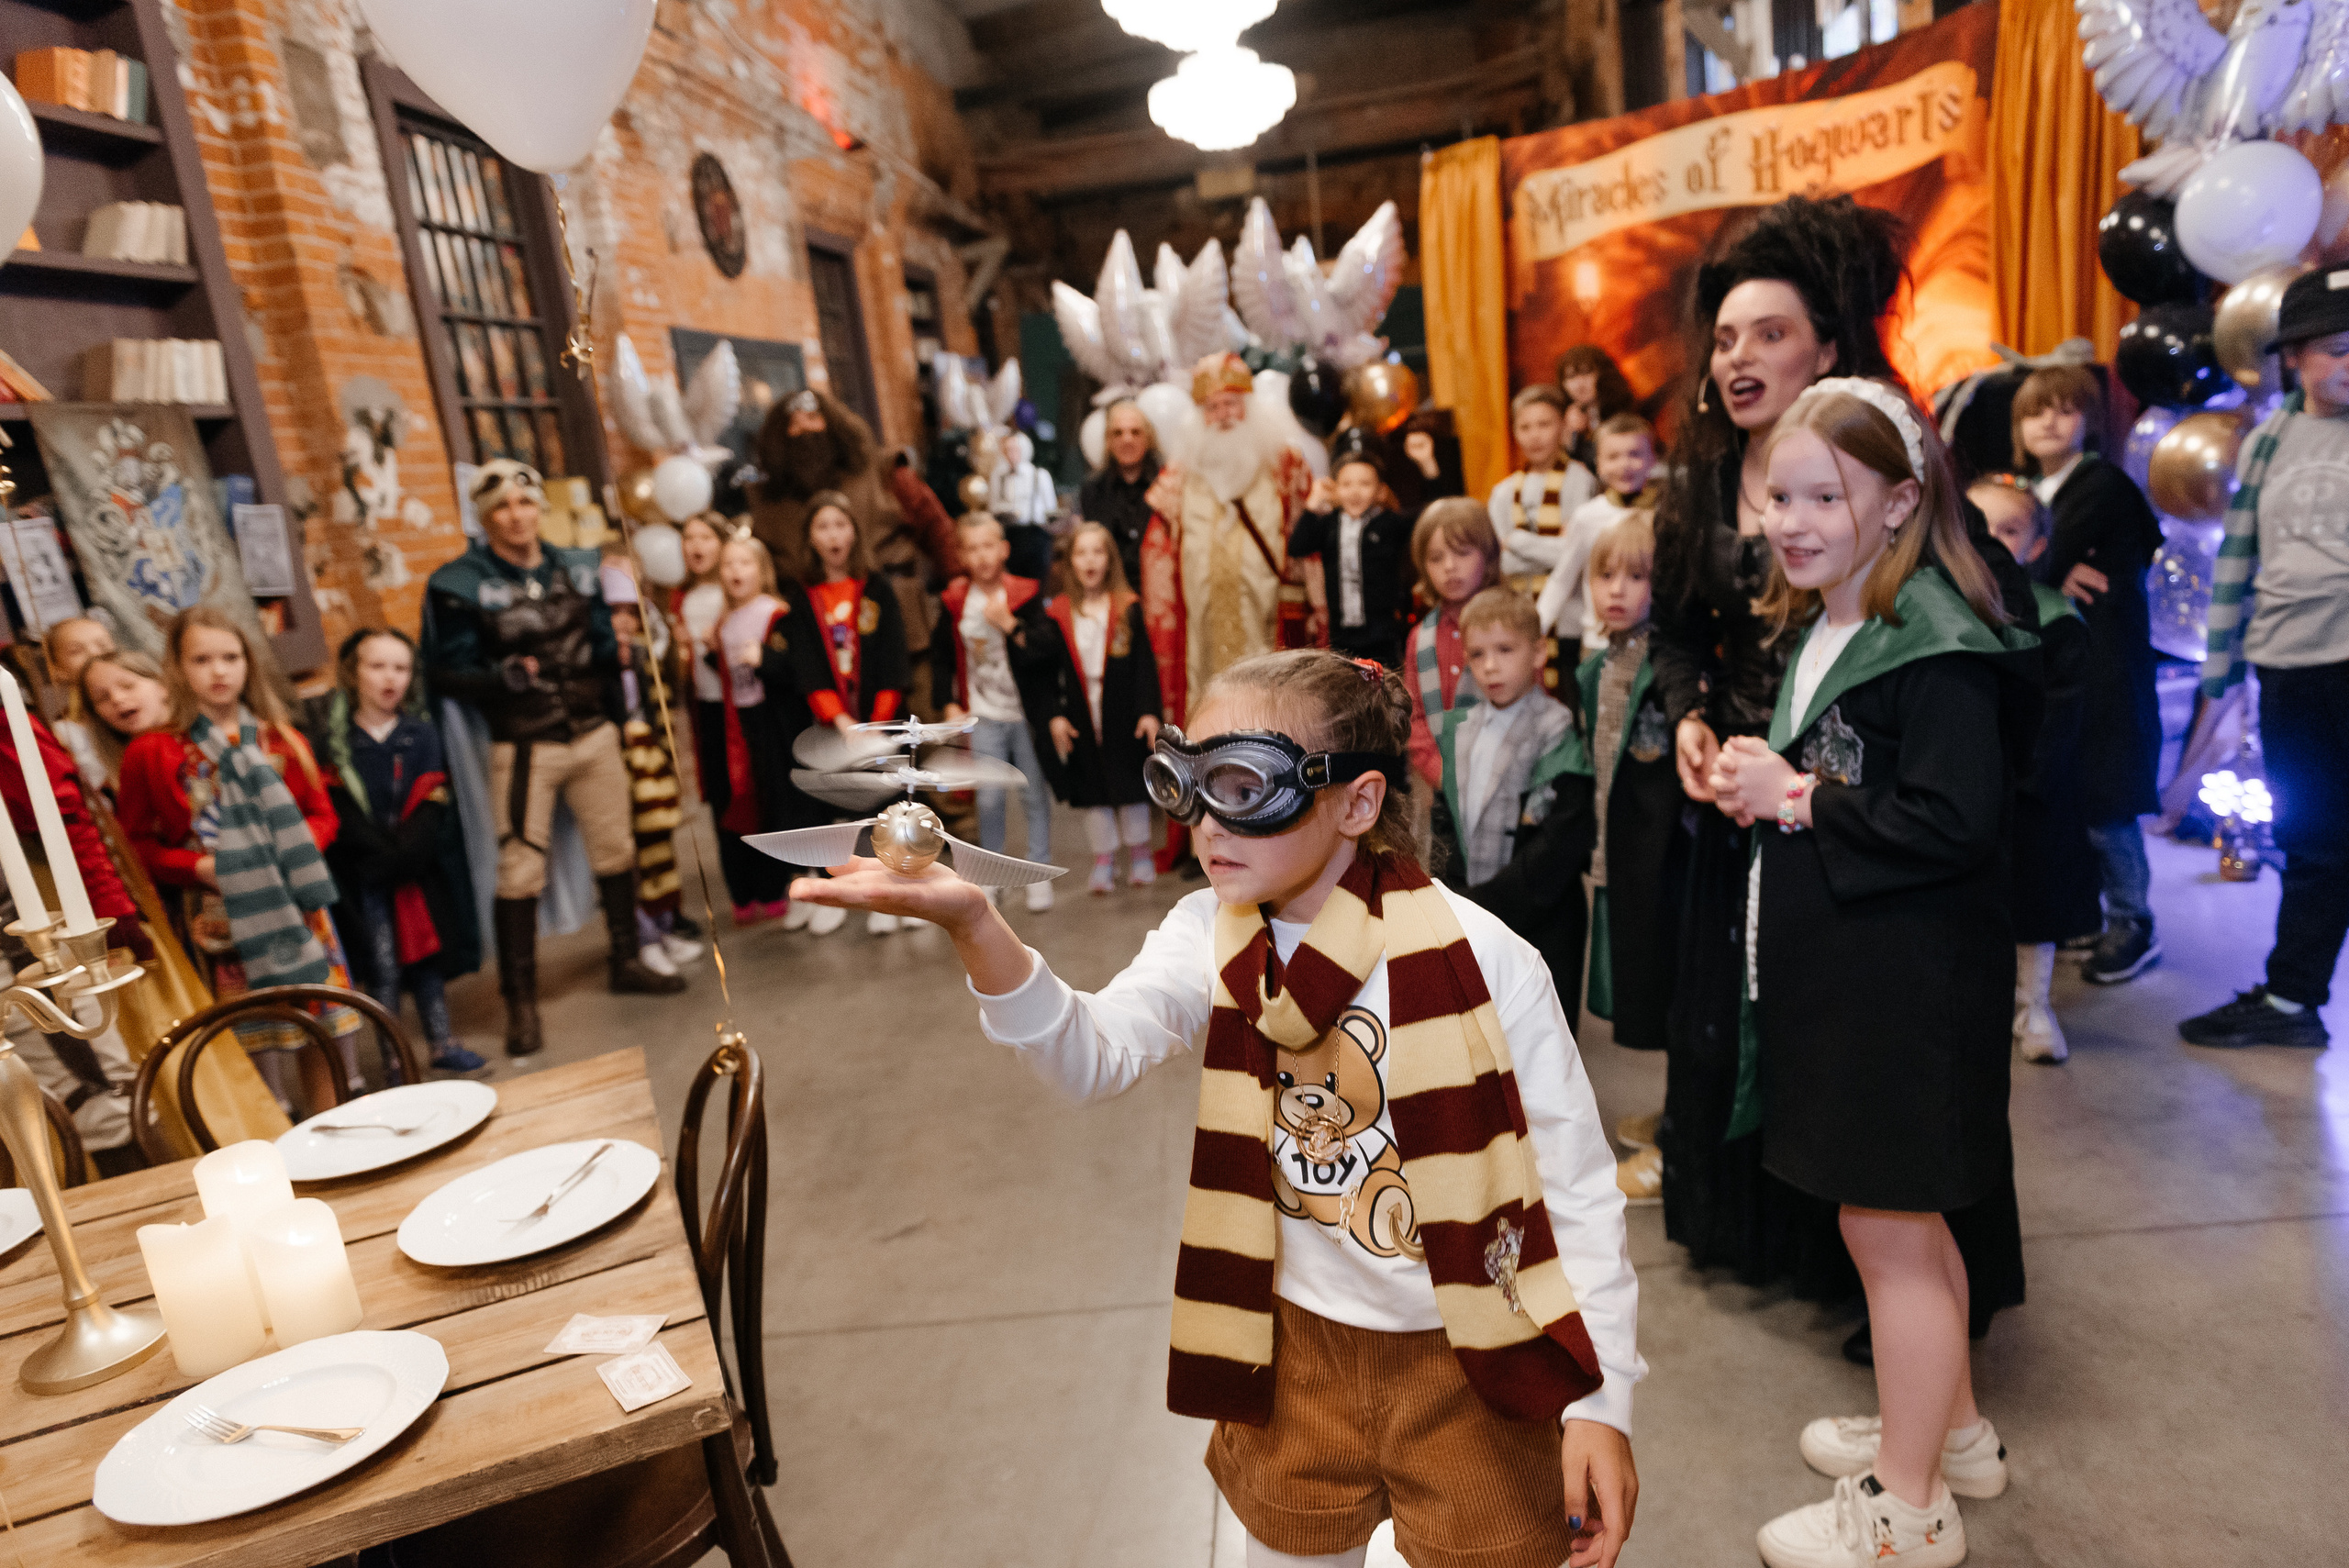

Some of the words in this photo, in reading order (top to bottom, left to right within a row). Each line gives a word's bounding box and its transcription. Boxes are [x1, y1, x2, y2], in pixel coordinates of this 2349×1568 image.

[1528, 158, 1668, 241] Miracles
[1686, 126, 1731, 195] of
[1749, 89, 1962, 194] Hogwarts
[1291, 1152, 1357, 1187] TOY
